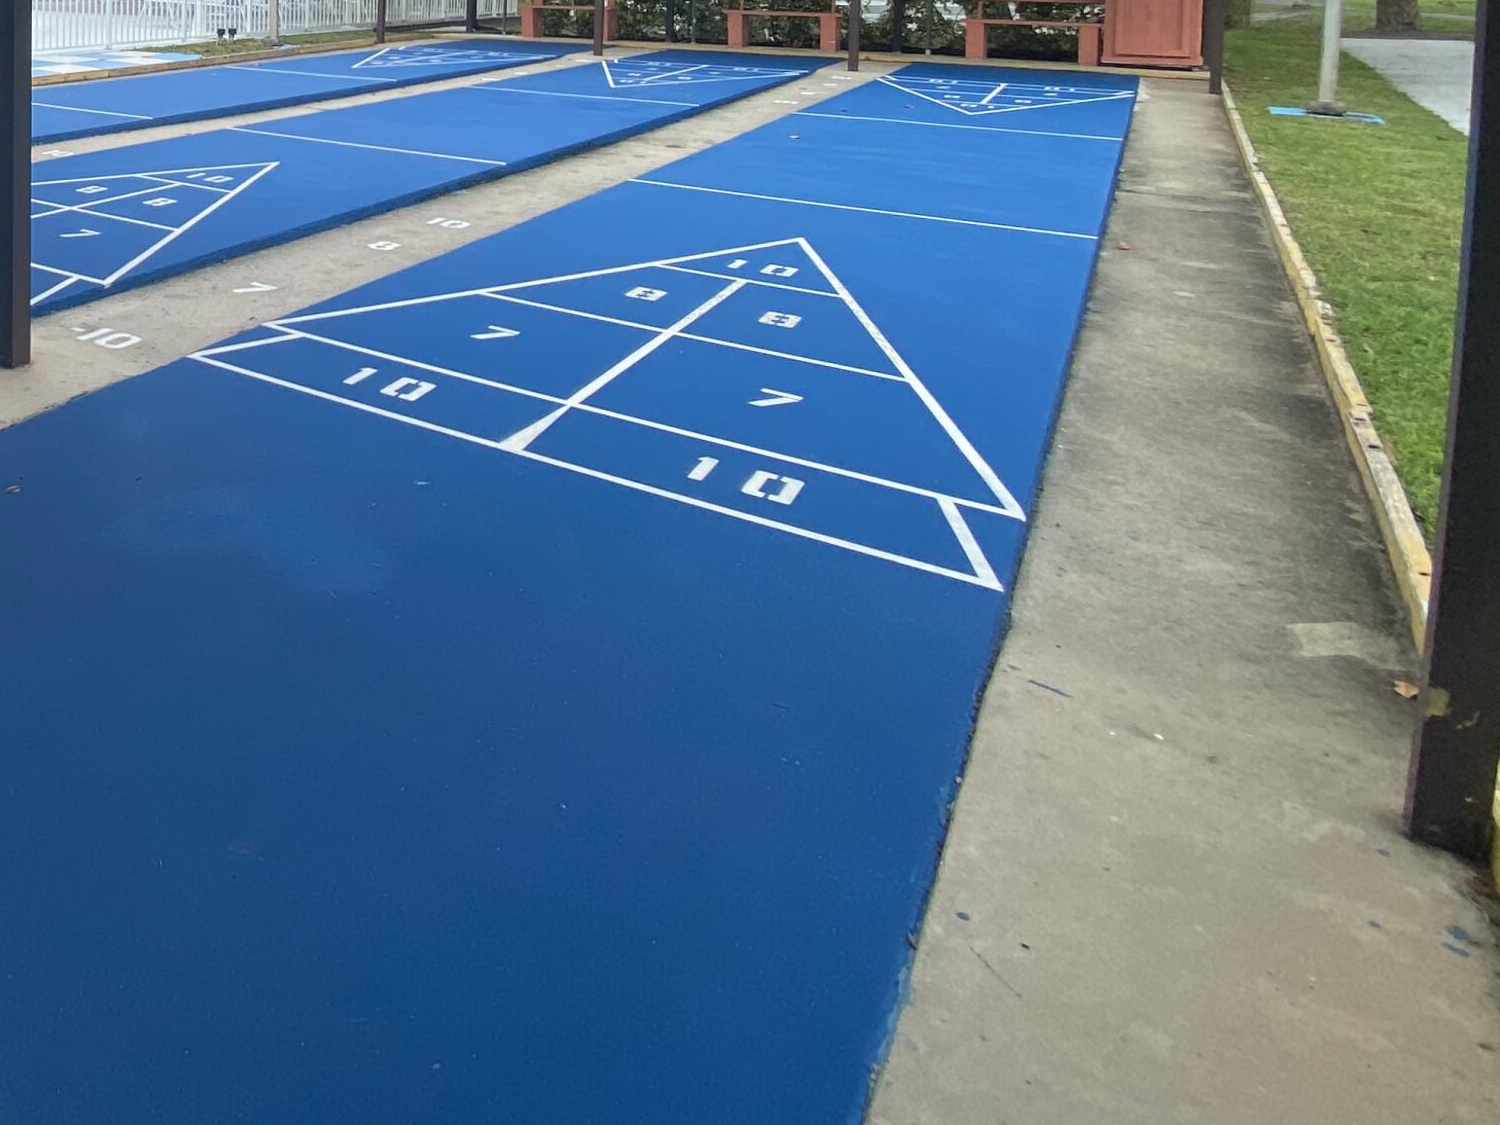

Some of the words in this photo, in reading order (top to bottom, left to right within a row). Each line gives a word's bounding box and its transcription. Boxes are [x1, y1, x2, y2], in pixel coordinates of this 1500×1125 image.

[186, 173, 234, 184] 10
[426, 217, 471, 229] 10
[367, 240, 402, 251] 8
[727, 258, 799, 278] 10
[624, 286, 668, 302] 8
[757, 311, 802, 329] 8
[470, 325, 521, 340] 7
[342, 367, 437, 402] 10
[747, 388, 804, 407] 7
[687, 456, 805, 505] 10
